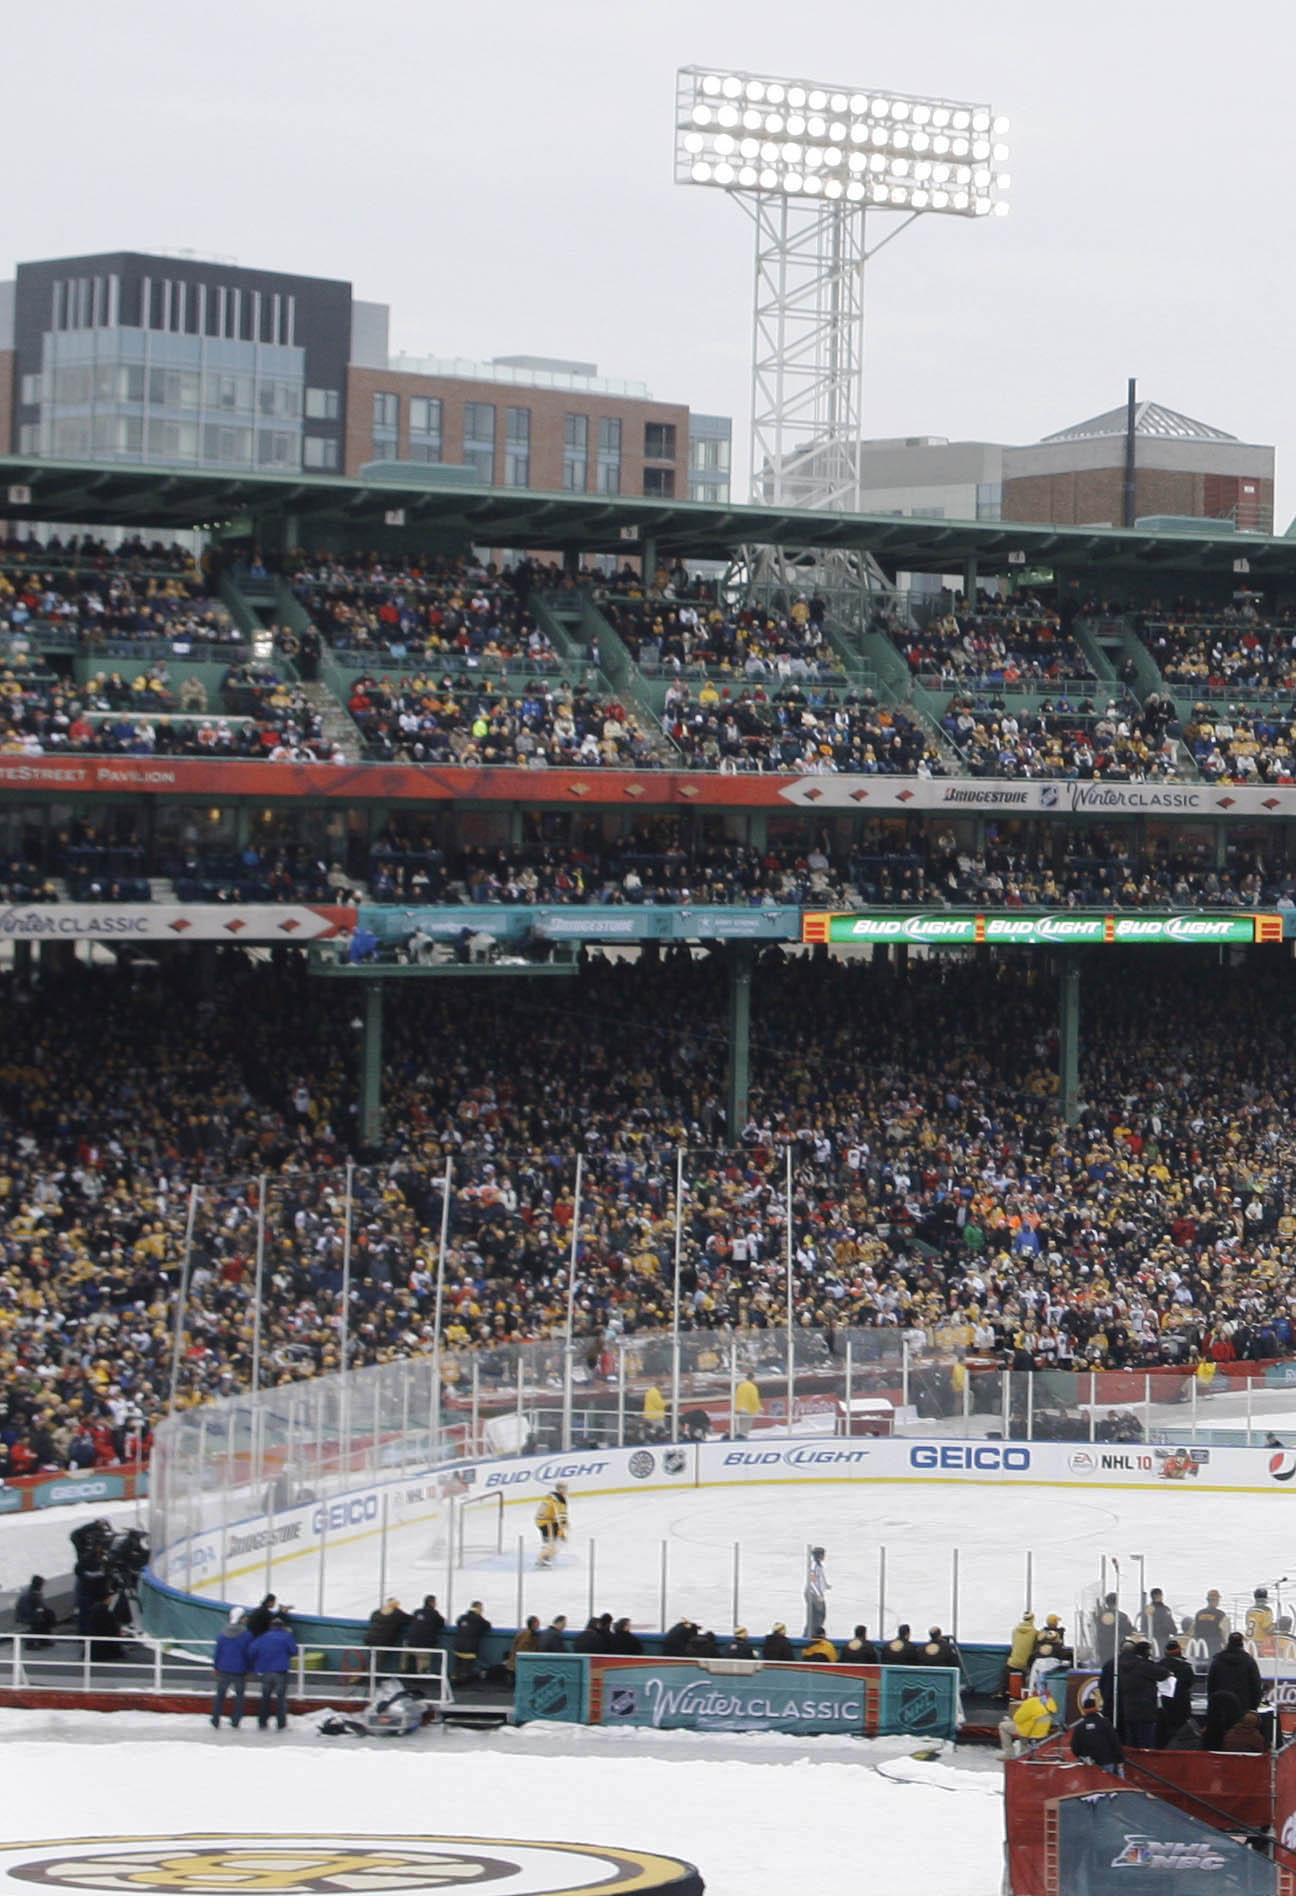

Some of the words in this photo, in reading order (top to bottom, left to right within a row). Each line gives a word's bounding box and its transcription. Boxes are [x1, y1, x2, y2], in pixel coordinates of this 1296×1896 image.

[97, 767, 176, 783] PAVILION
[943, 787, 1028, 804] BRIDGESTONE
[1066, 782, 1129, 812] Winter
[1128, 794, 1200, 807] CLASSIC
[0, 907, 56, 933] inter
[58, 917, 149, 933] CLASSIC
[852, 920, 901, 934] BUD
[909, 920, 972, 934] LIGHT
[986, 920, 1034, 934] BUD
[1042, 920, 1102, 935] LIGHT
[1115, 920, 1165, 935] BUD
[1172, 920, 1235, 935] LIGHT
[723, 1451, 786, 1466] BUD
[794, 1450, 871, 1464] LIGHT
[910, 1446, 1031, 1471] GEICO
[1101, 1455, 1134, 1470] NHL
[1136, 1456, 1152, 1470] 10
[485, 1470, 532, 1487] BUD
[542, 1461, 610, 1481] LIGHT
[51, 1481, 107, 1500] GEICO
[312, 1495, 378, 1535] GEICO
[645, 1678, 744, 1727] Winter
[747, 1699, 860, 1720] CLASSIC
[1147, 1841, 1212, 1857] NHL
[1149, 1855, 1226, 1871] NBC
